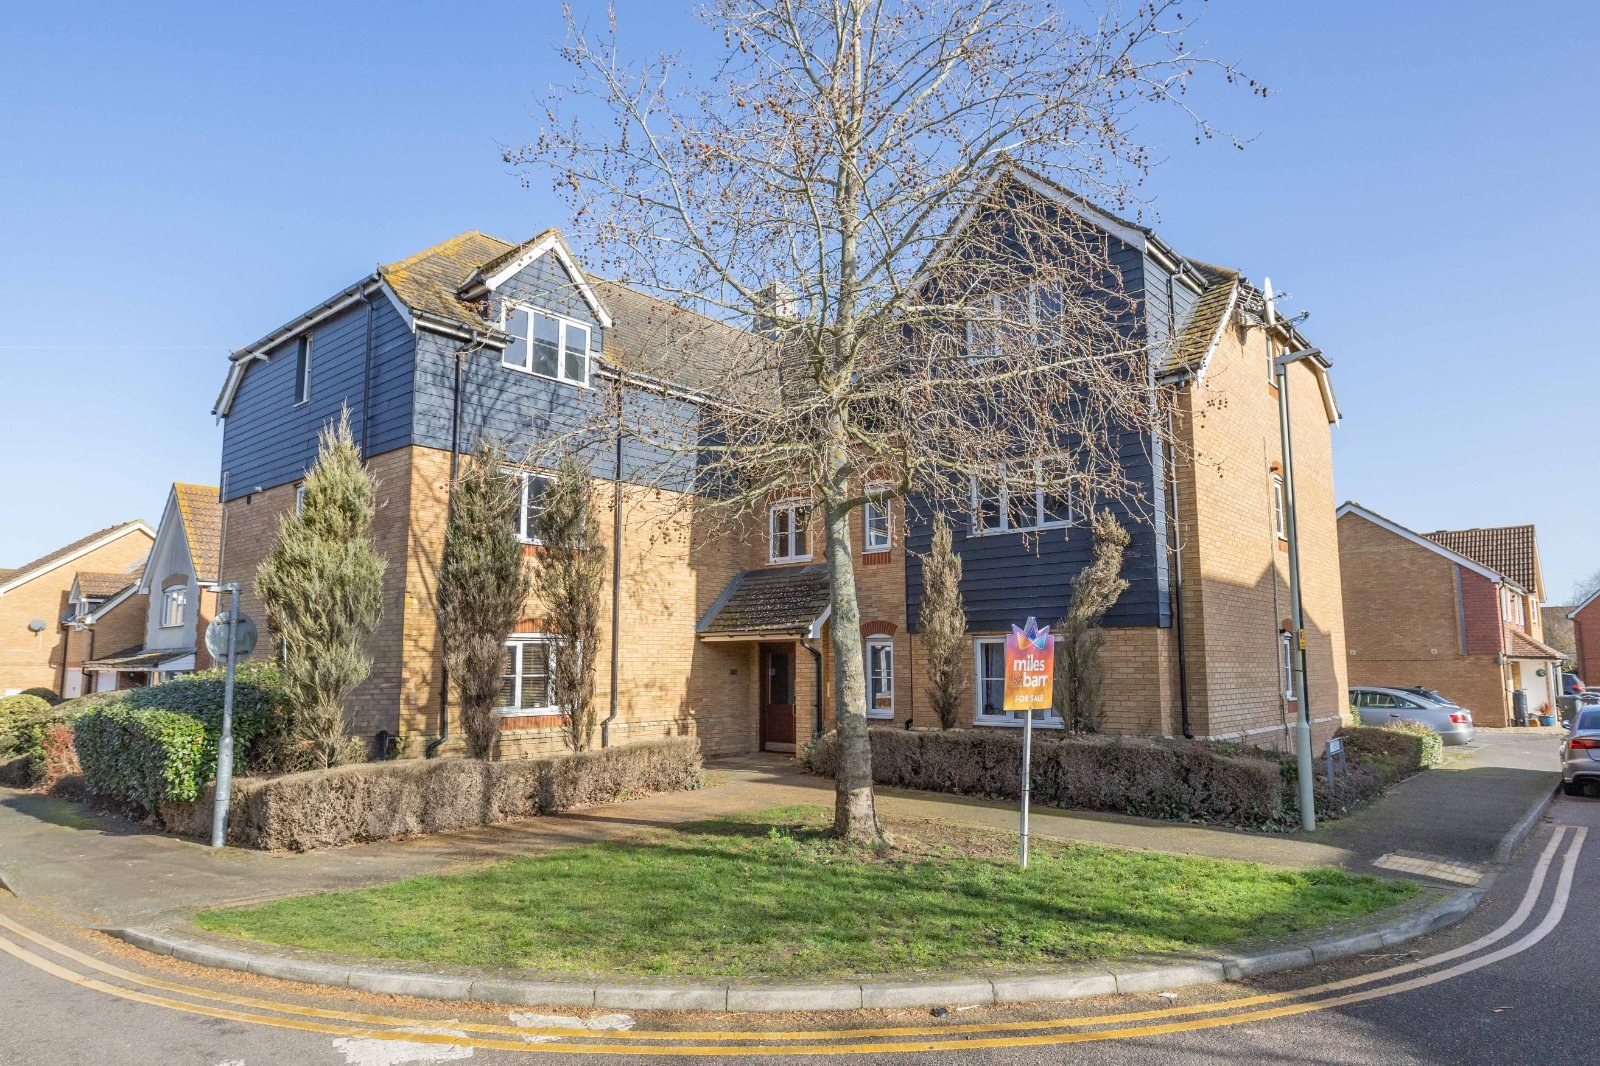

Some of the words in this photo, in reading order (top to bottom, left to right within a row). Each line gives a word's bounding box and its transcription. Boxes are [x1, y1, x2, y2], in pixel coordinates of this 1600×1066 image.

[1013, 654, 1045, 671] miles
[1023, 671, 1048, 687] barr
[1030, 694, 1044, 702] SALE
